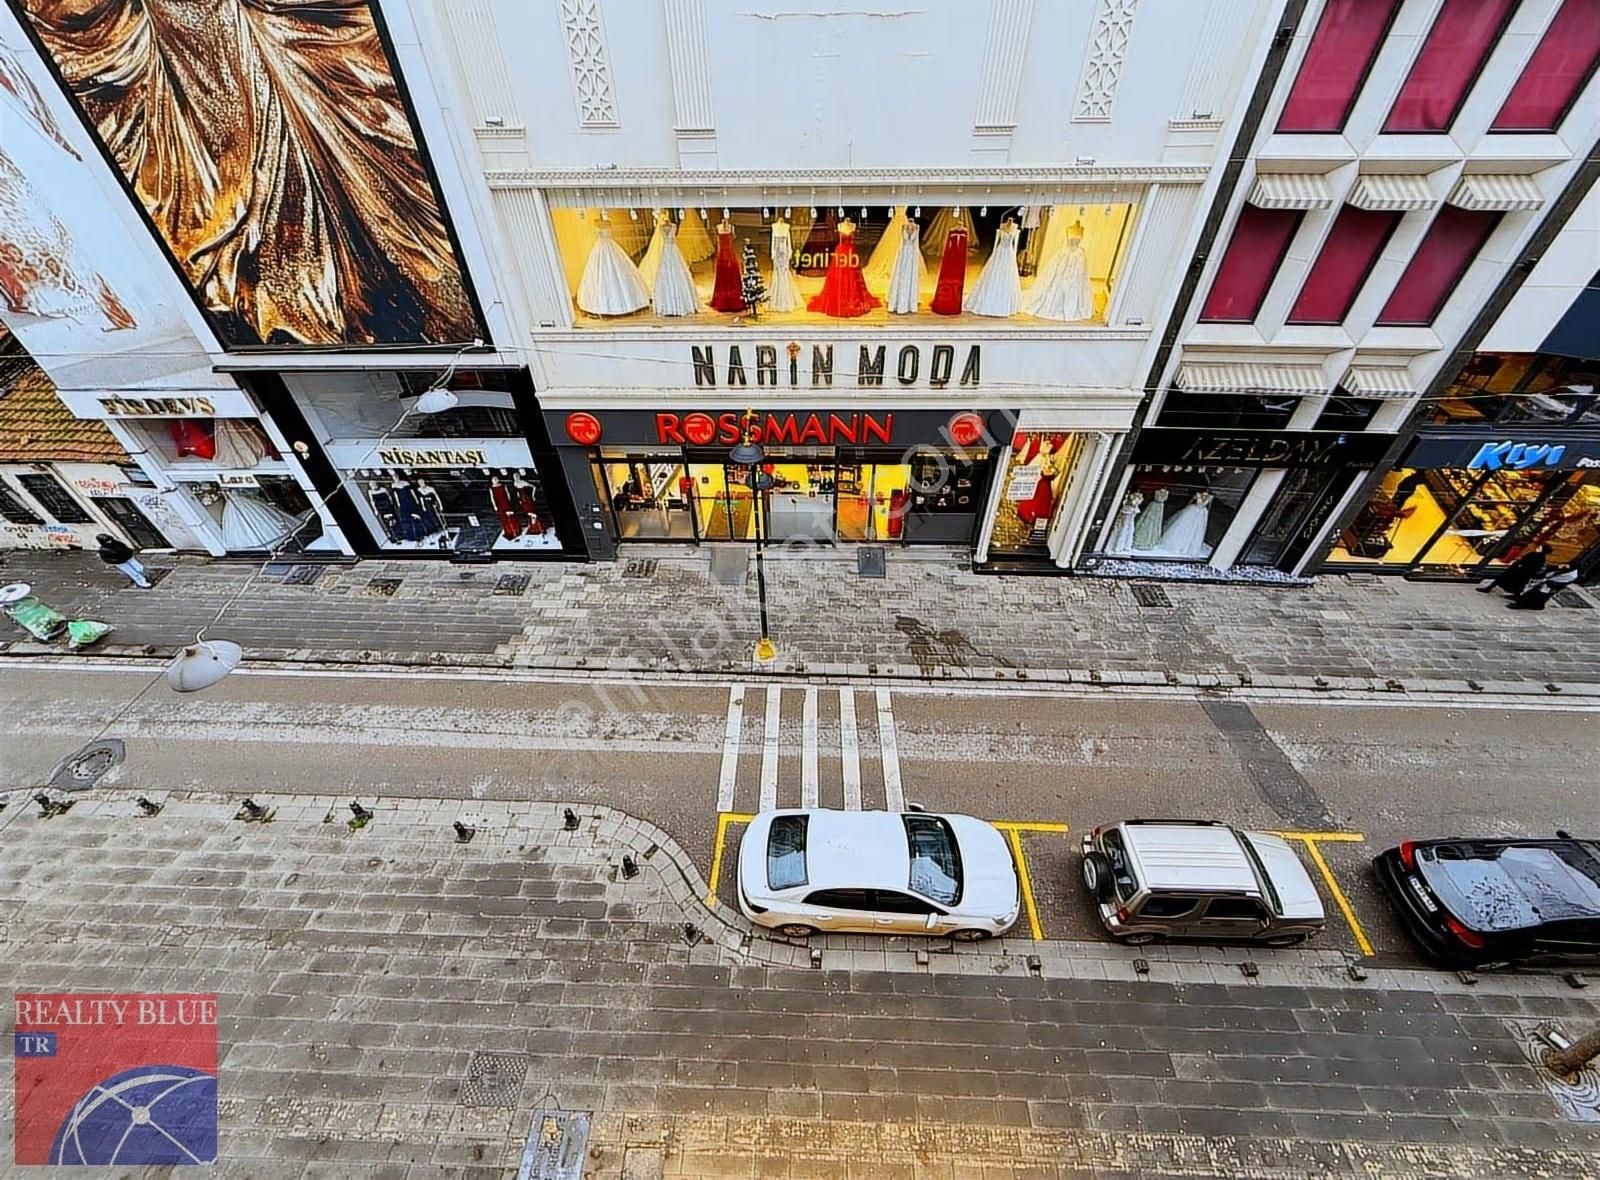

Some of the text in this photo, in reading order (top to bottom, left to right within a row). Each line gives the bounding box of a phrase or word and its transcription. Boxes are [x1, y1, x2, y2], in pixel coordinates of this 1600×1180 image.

[858, 344, 981, 385] MODA
[656, 412, 893, 446] ROSSMANN
[378, 447, 488, 467] NİŞANTAŞI
